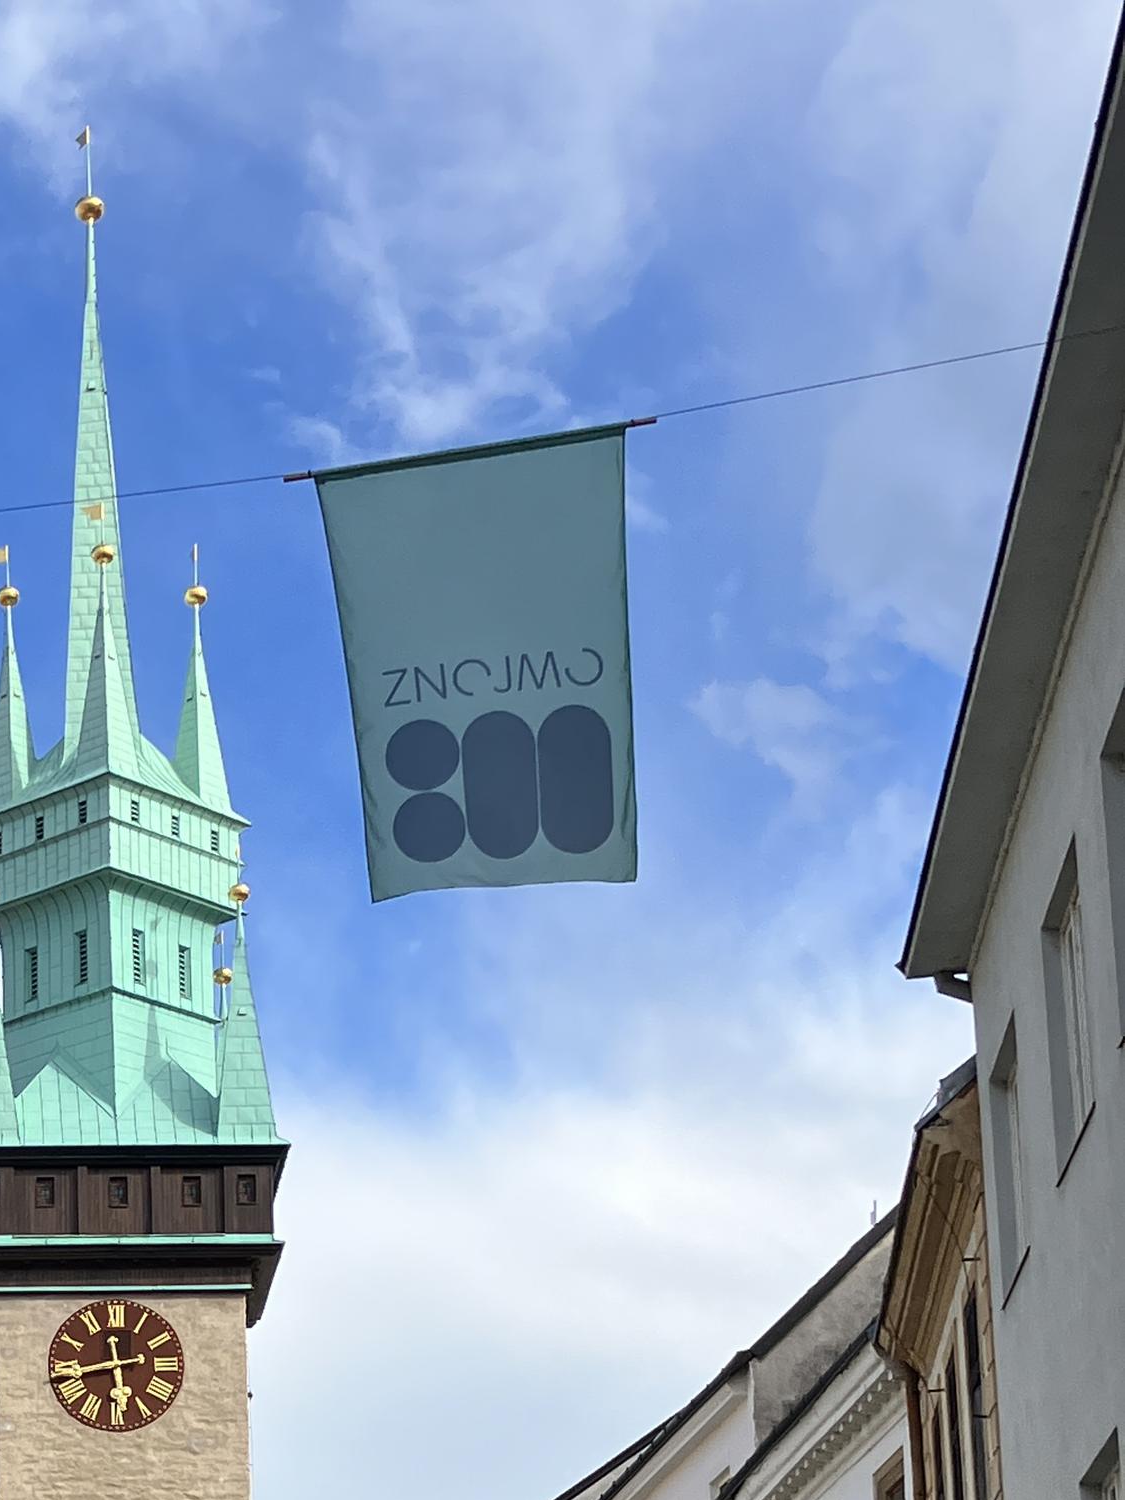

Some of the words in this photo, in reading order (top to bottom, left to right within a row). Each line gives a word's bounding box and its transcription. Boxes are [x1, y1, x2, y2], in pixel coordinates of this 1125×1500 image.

[381, 647, 604, 708] ZNOJMO
[79, 1311, 101, 1336] XI
[107, 1304, 125, 1328] XII
[133, 1312, 149, 1334] I
[60, 1332, 84, 1352] X
[147, 1331, 171, 1351] II
[154, 1357, 179, 1372] III
[135, 1397, 152, 1418] V
